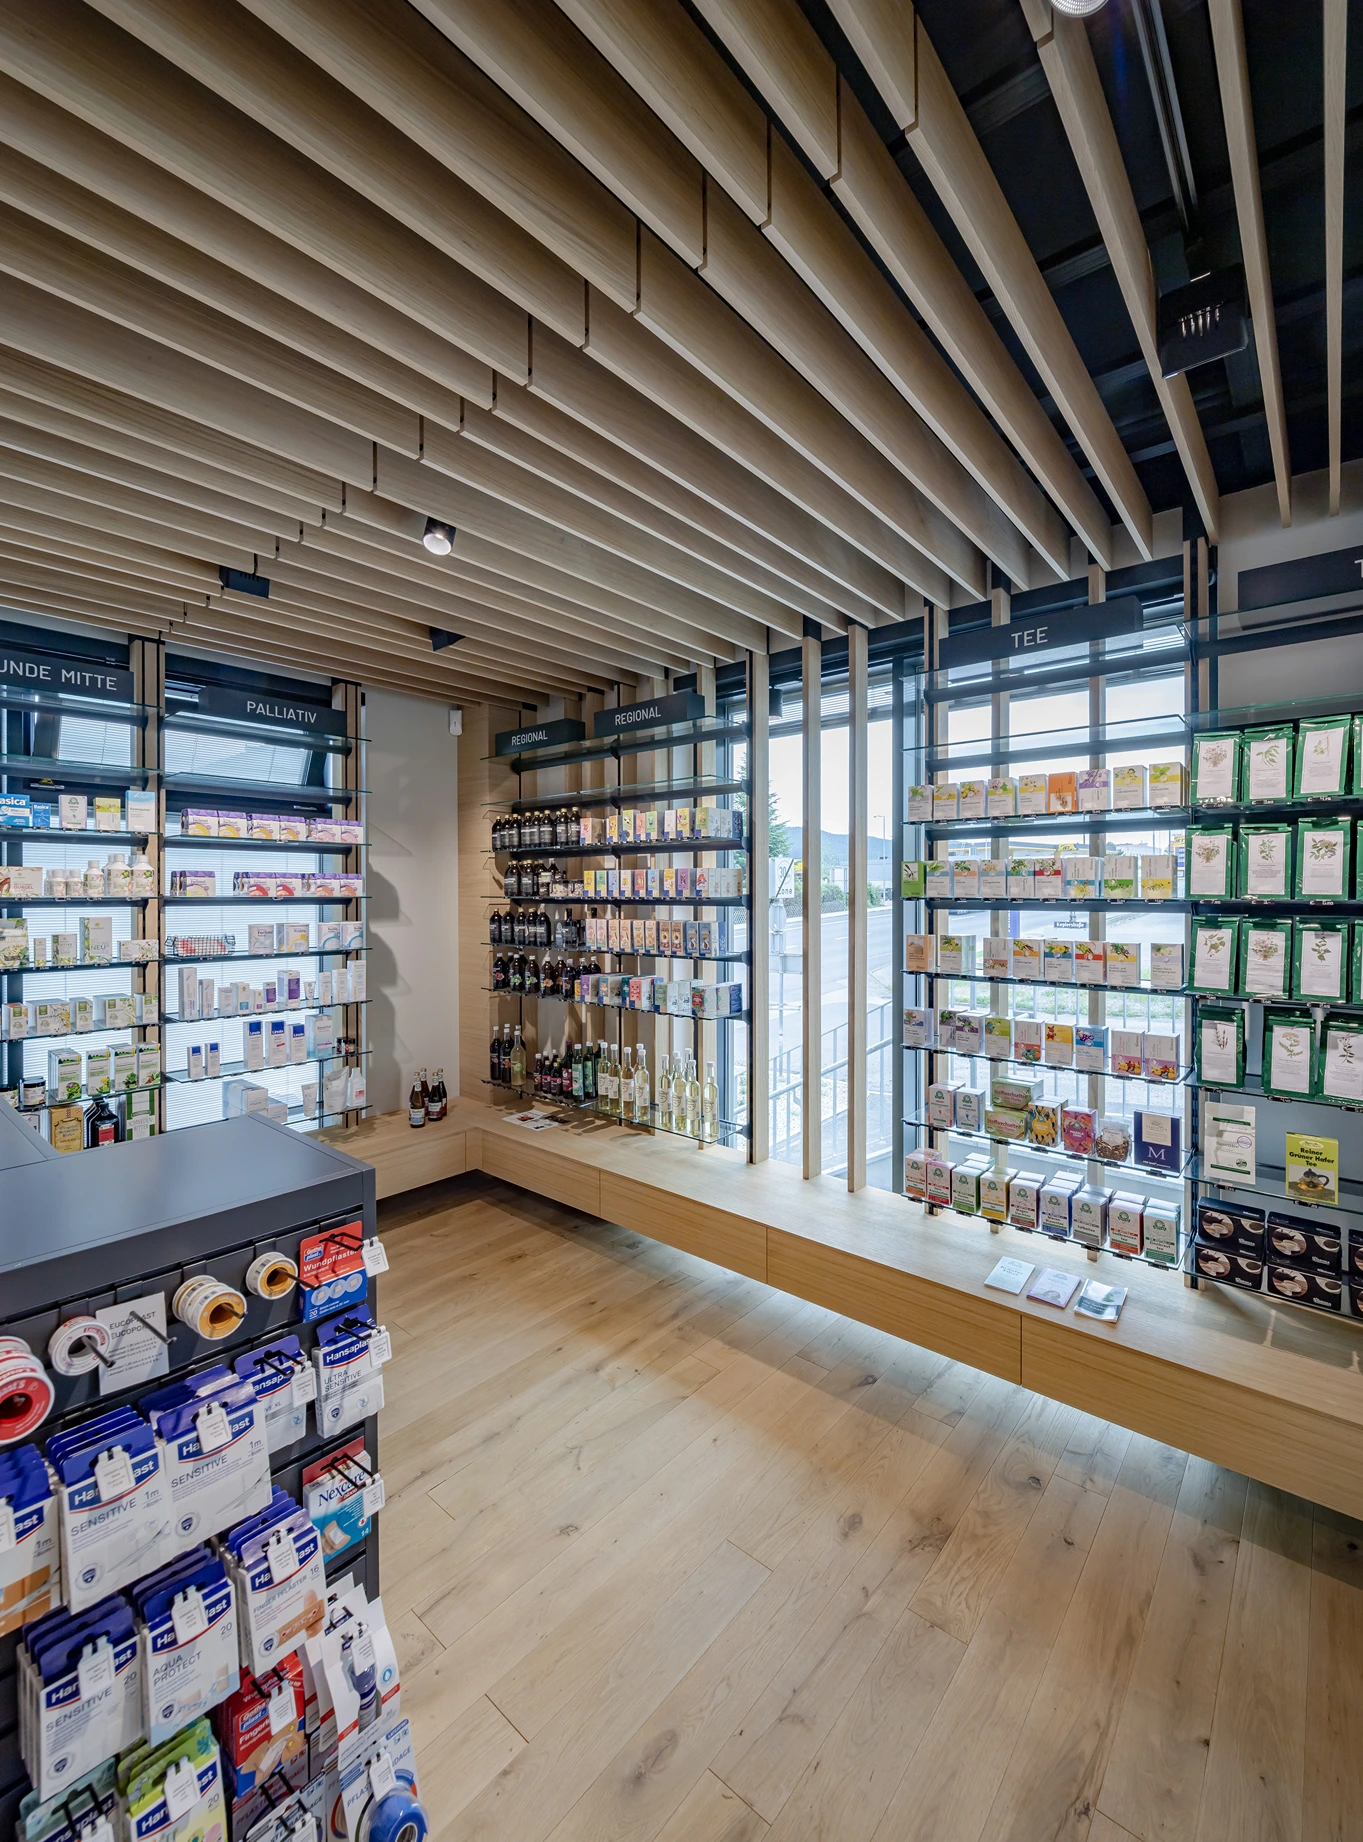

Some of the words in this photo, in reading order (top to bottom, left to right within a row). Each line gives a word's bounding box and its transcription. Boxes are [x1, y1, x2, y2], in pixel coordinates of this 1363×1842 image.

[1010, 626, 1049, 649] TEE
[61, 668, 118, 691] MITTE
[246, 700, 317, 724] PALLIATIV
[615, 706, 662, 726] REGIONAL
[511, 729, 549, 747] REGIONAL
[1147, 1146, 1167, 1160] M
[1289, 1151, 1314, 1161] Grüner
[1315, 1155, 1335, 1164] Hafer
[1300, 1147, 1324, 1157] Reiner
[1305, 1160, 1318, 1168] Tee
[303, 1249, 358, 1273] Wundpflaste
[109, 1310, 157, 1330] EUCOPAST
[326, 1338, 371, 1364] Hansaplas
[324, 1369, 349, 1385] ULTRA
[324, 1370, 362, 1393] SENSITIVE
[171, 1453, 229, 1489] SENSITIVE
[70, 1497, 137, 1537] SENSITIVE
[361, 1527, 370, 1537] 14
[310, 1564, 320, 1575] 16
[253, 1595, 278, 1614] FINGER
[277, 1574, 308, 1601] PFLASTER
[220, 1621, 233, 1636] 20
[152, 1654, 184, 1678] AQUA
[153, 1650, 203, 1688] PROTECT
[123, 1671, 138, 1686] 20
[45, 1685, 113, 1733] SENSITIVE
[239, 1718, 271, 1745] Fingerk
[207, 1793, 220, 1809] 20
